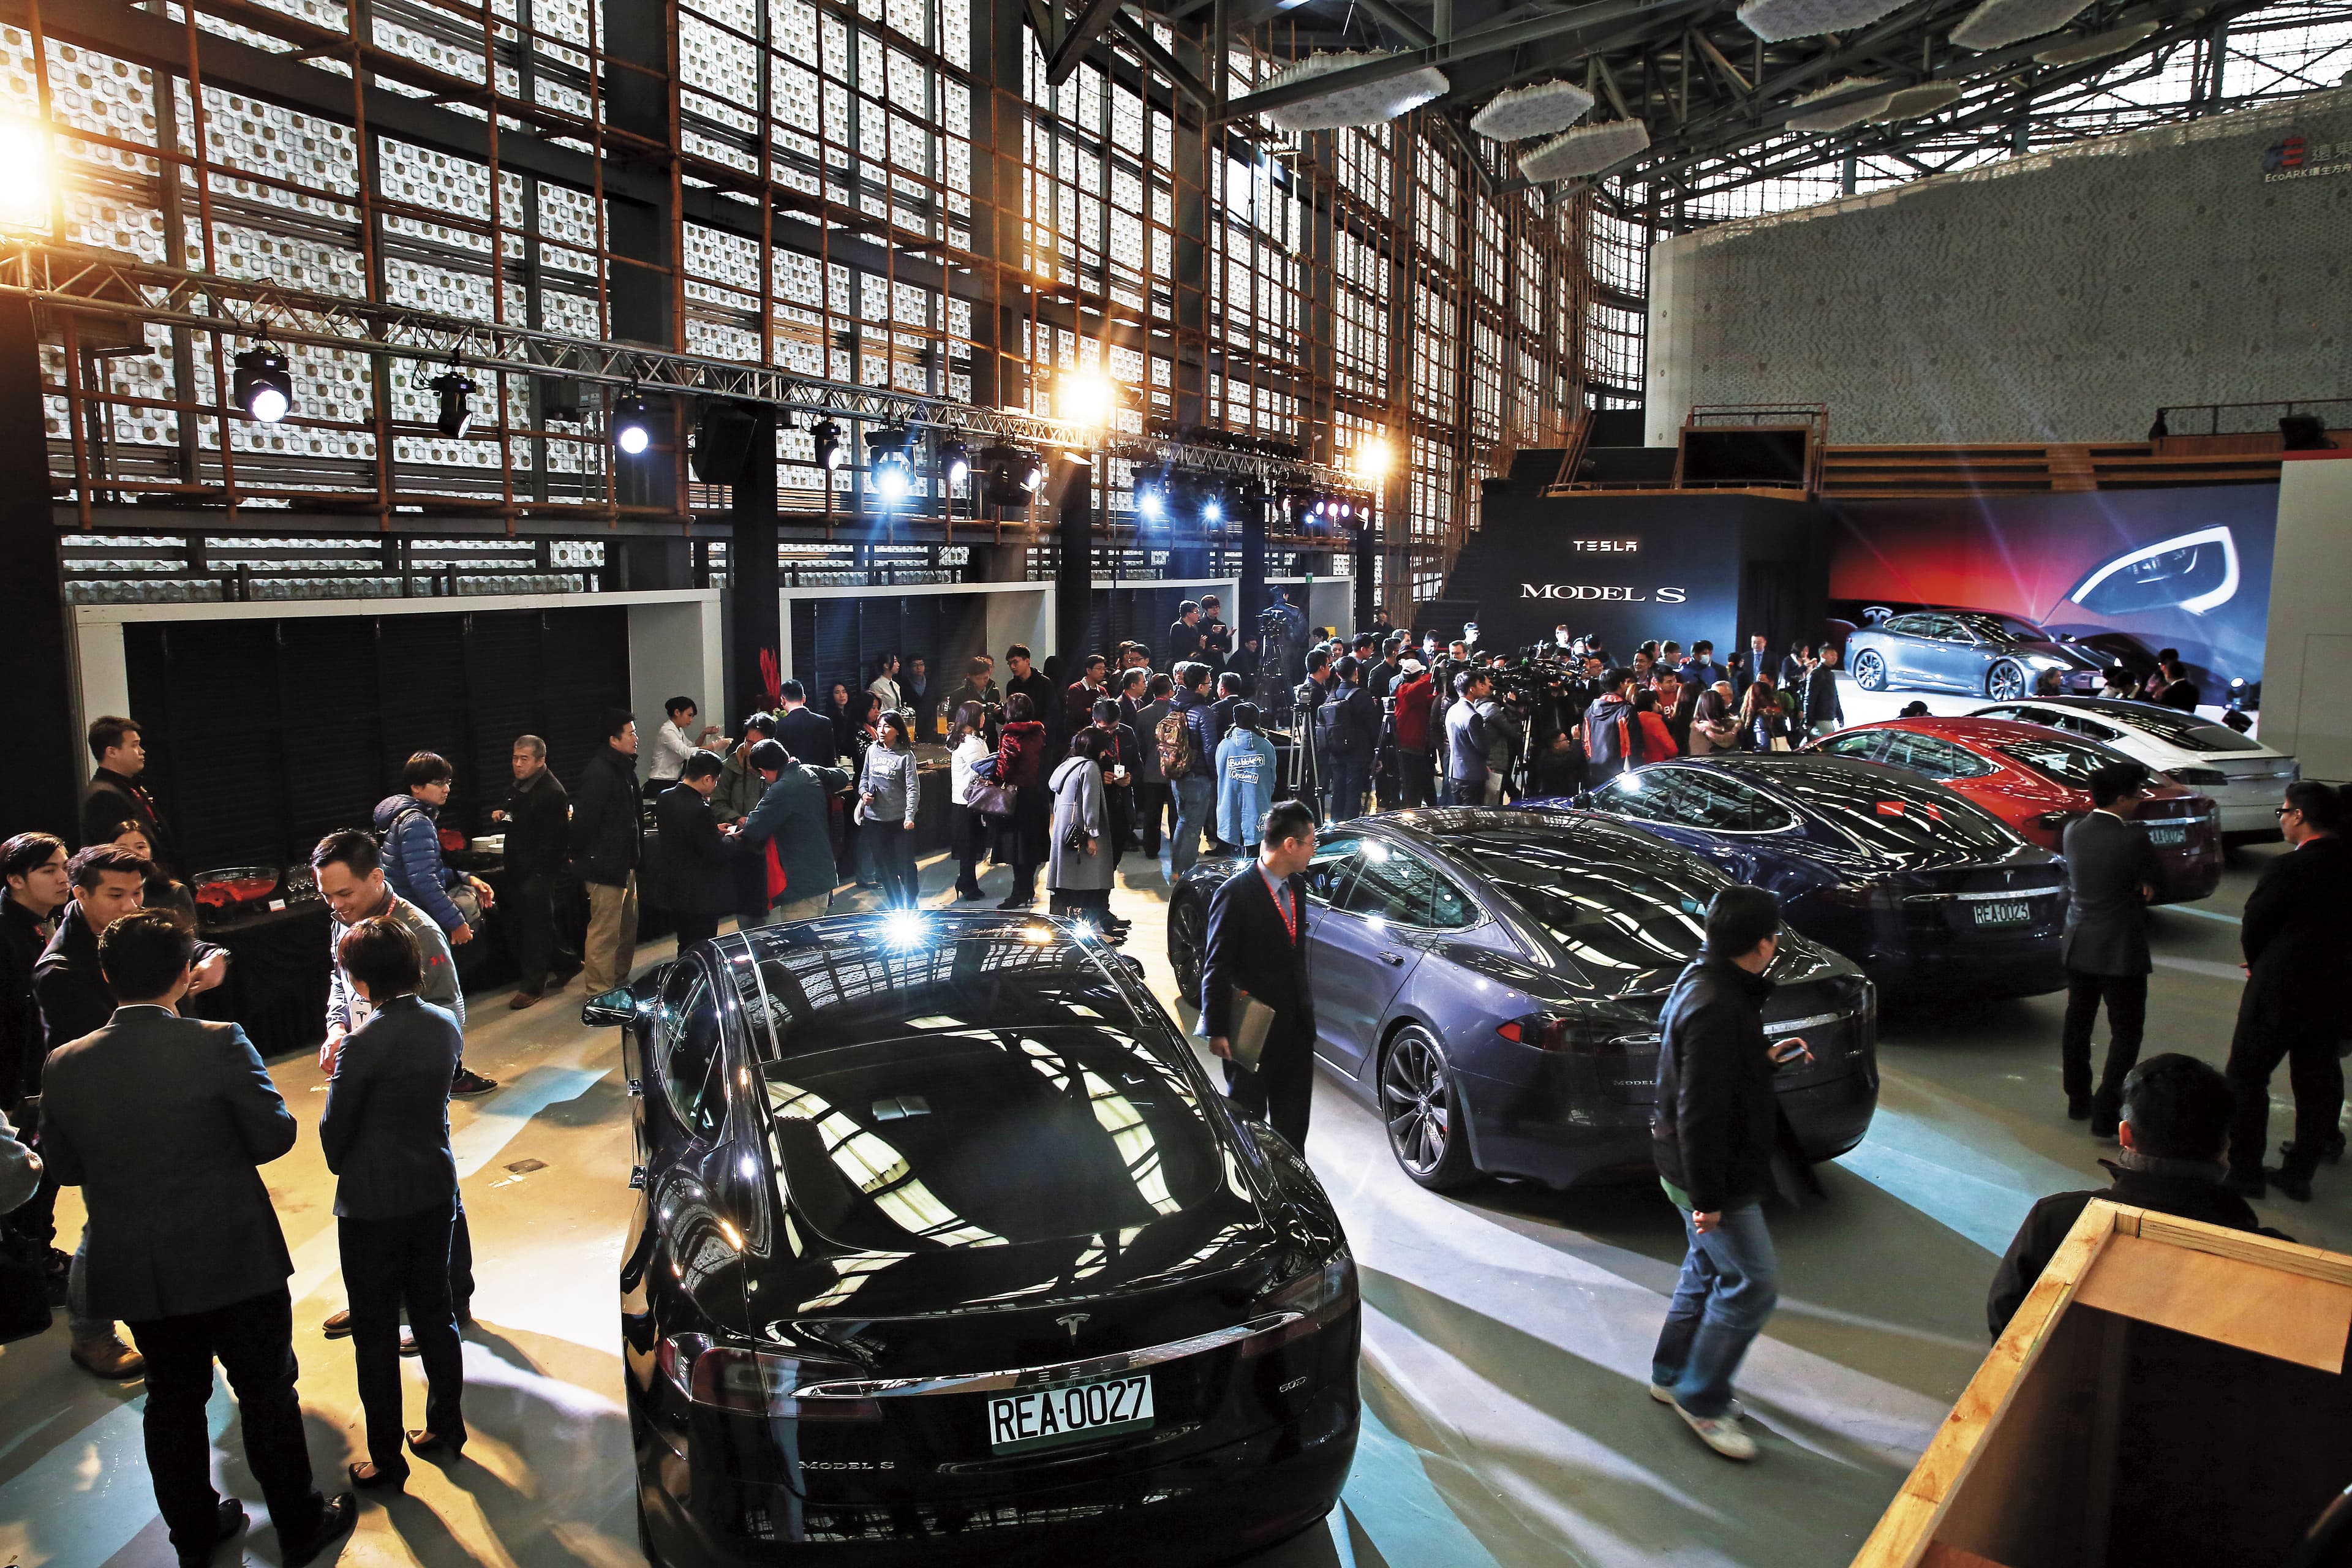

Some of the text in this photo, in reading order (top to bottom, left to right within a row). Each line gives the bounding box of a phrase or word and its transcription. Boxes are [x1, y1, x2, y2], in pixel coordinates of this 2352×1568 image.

[1573, 541, 1637, 552] TESLA
[1520, 583, 1686, 603] MODEL S
[872, 756, 897, 769] ROOTS
[1229, 757, 1255, 767] Bubble
[1279, 1376, 1307, 1393] 60D
